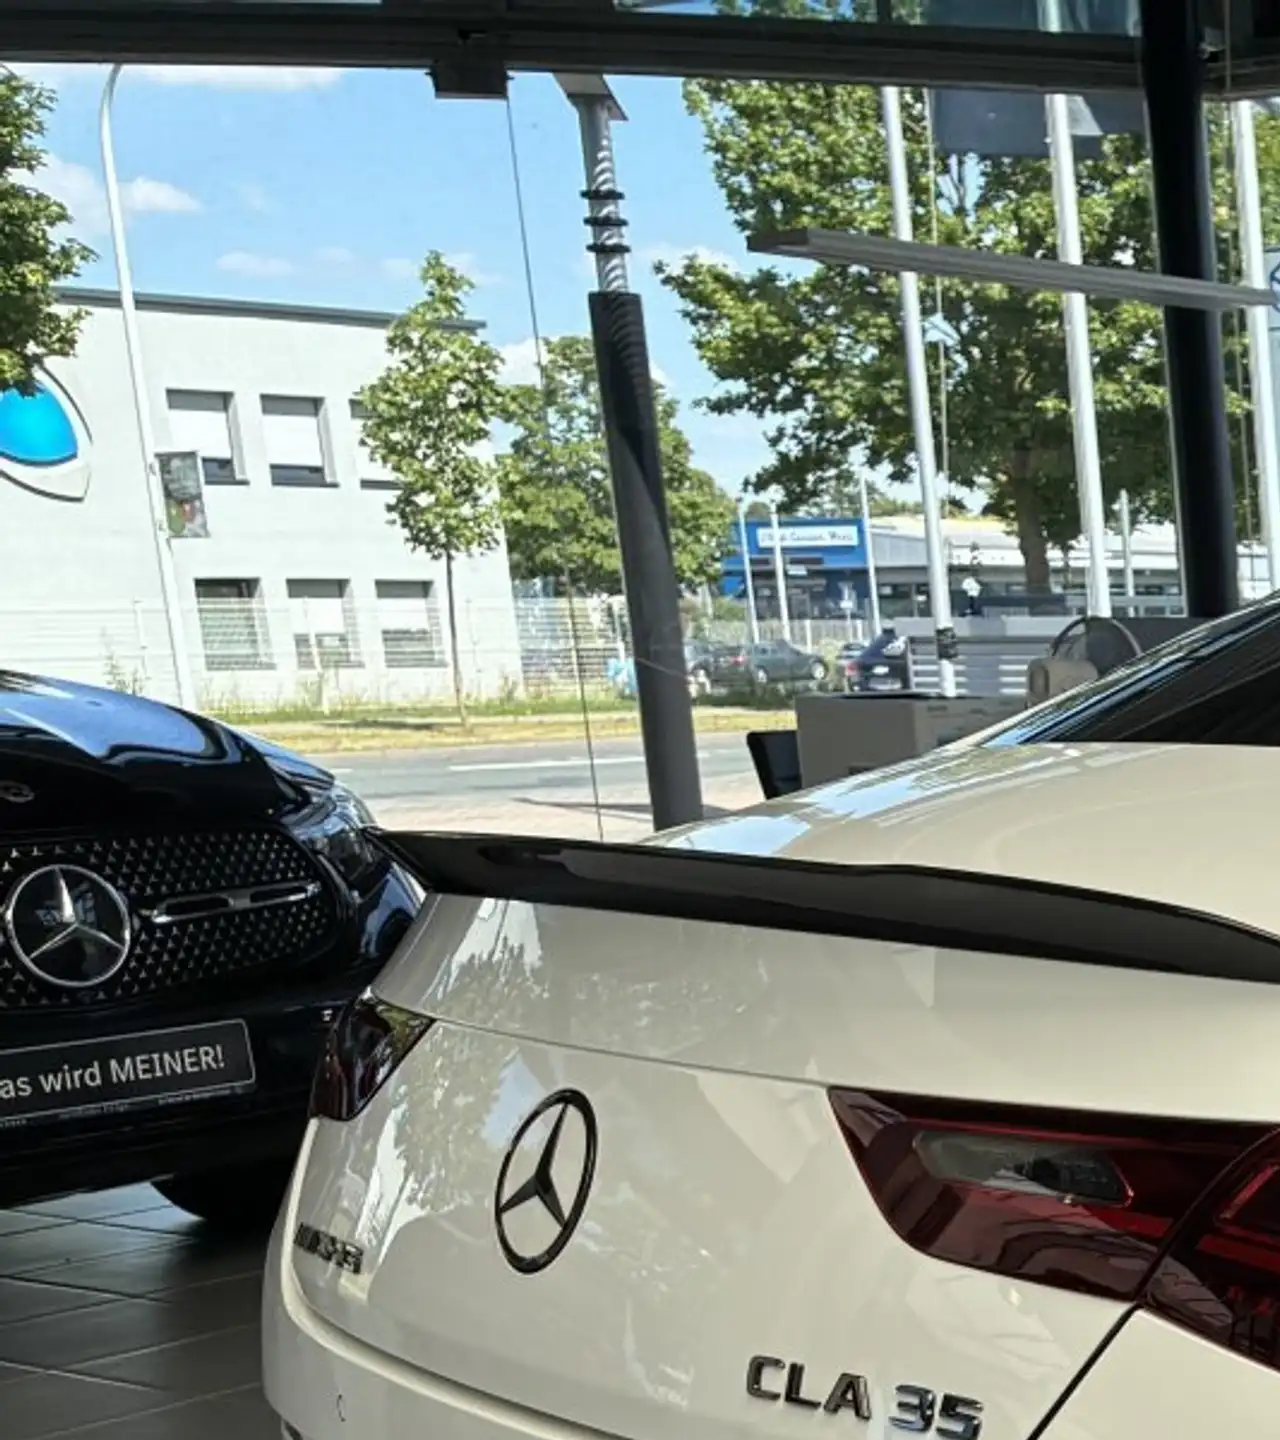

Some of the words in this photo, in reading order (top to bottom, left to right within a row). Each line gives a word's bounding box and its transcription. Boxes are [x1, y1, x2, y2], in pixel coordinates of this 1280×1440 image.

[0, 1076, 32, 1099] as
[38, 1061, 102, 1094] wird
[109, 1044, 226, 1085] MEINER!
[746, 1355, 872, 1421] CLA
